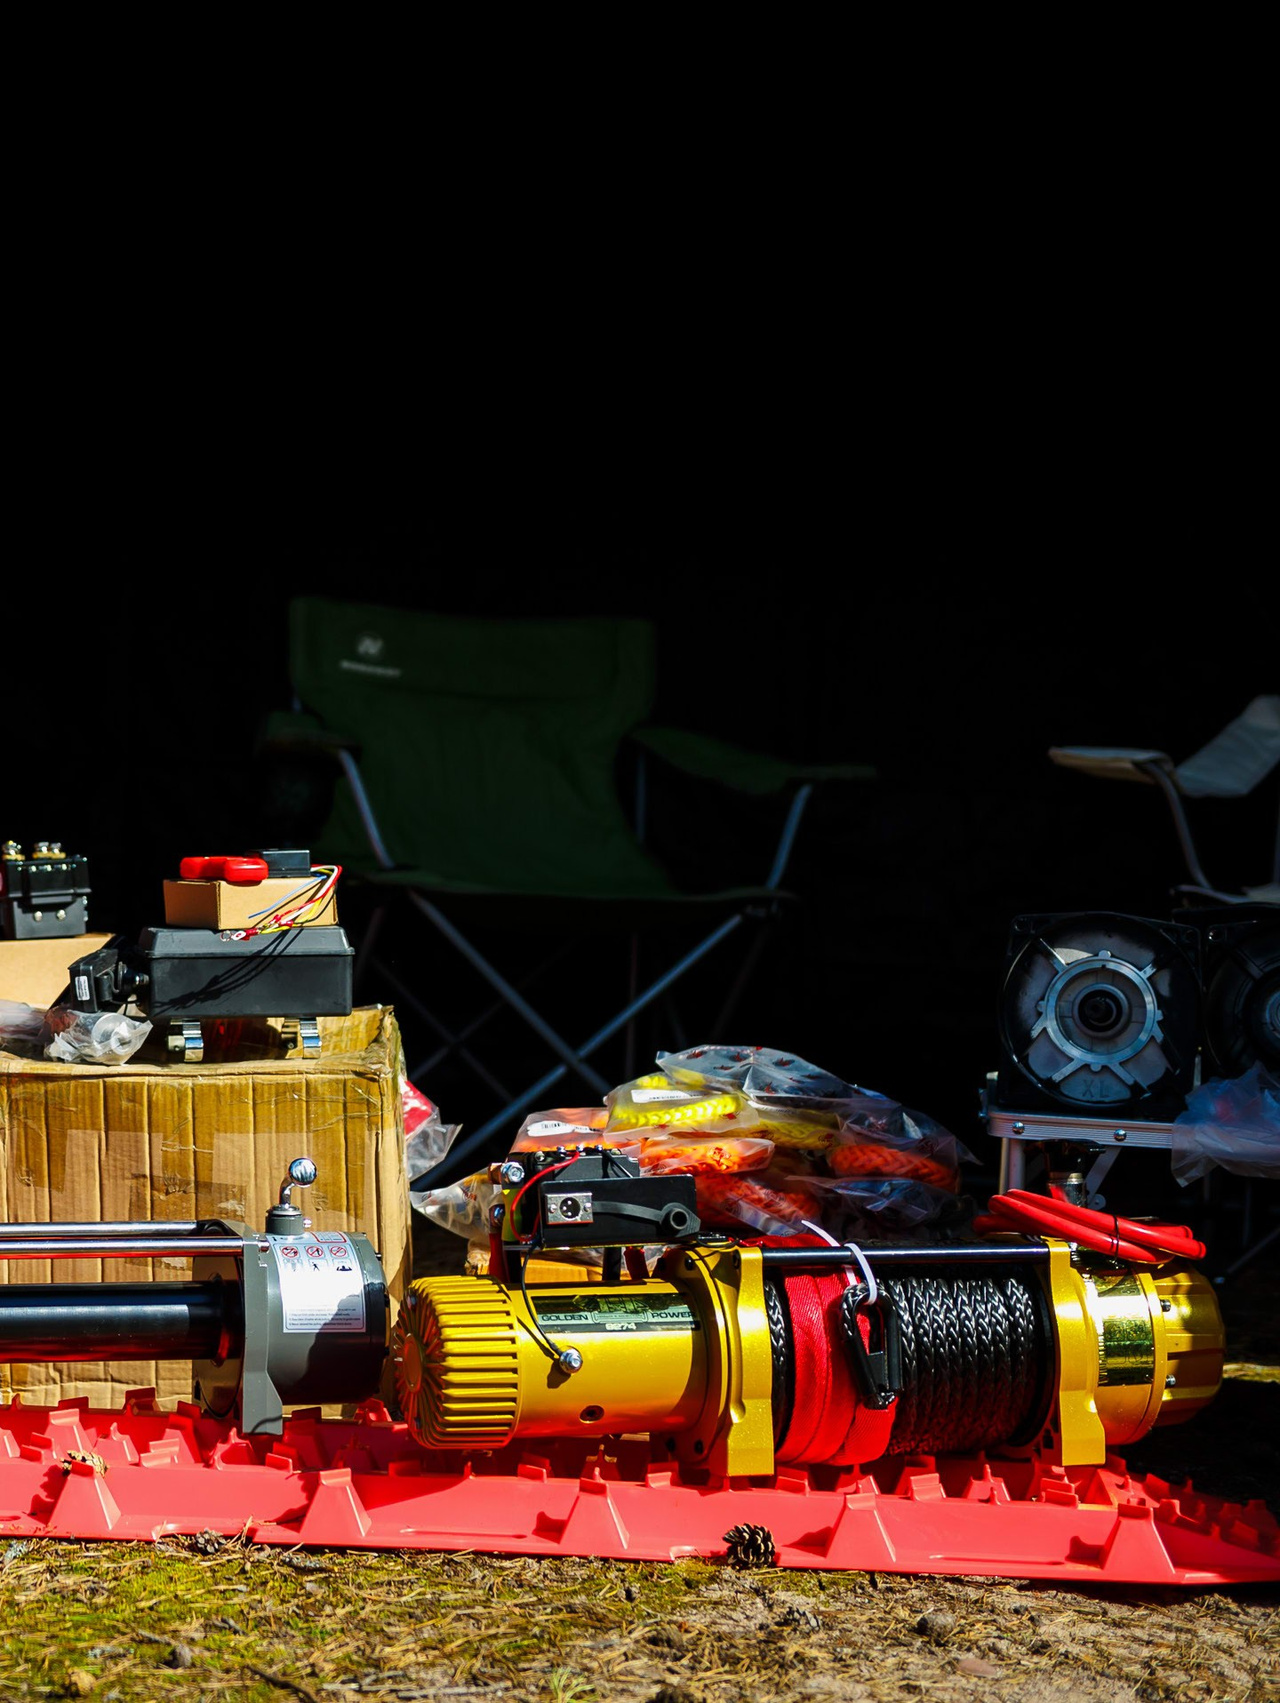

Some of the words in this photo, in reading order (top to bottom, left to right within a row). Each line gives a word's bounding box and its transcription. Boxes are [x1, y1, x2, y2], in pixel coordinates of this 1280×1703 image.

[1083, 1079, 1110, 1098] XL
[541, 1313, 589, 1322] GOLDEN
[650, 1310, 696, 1320] POWER
